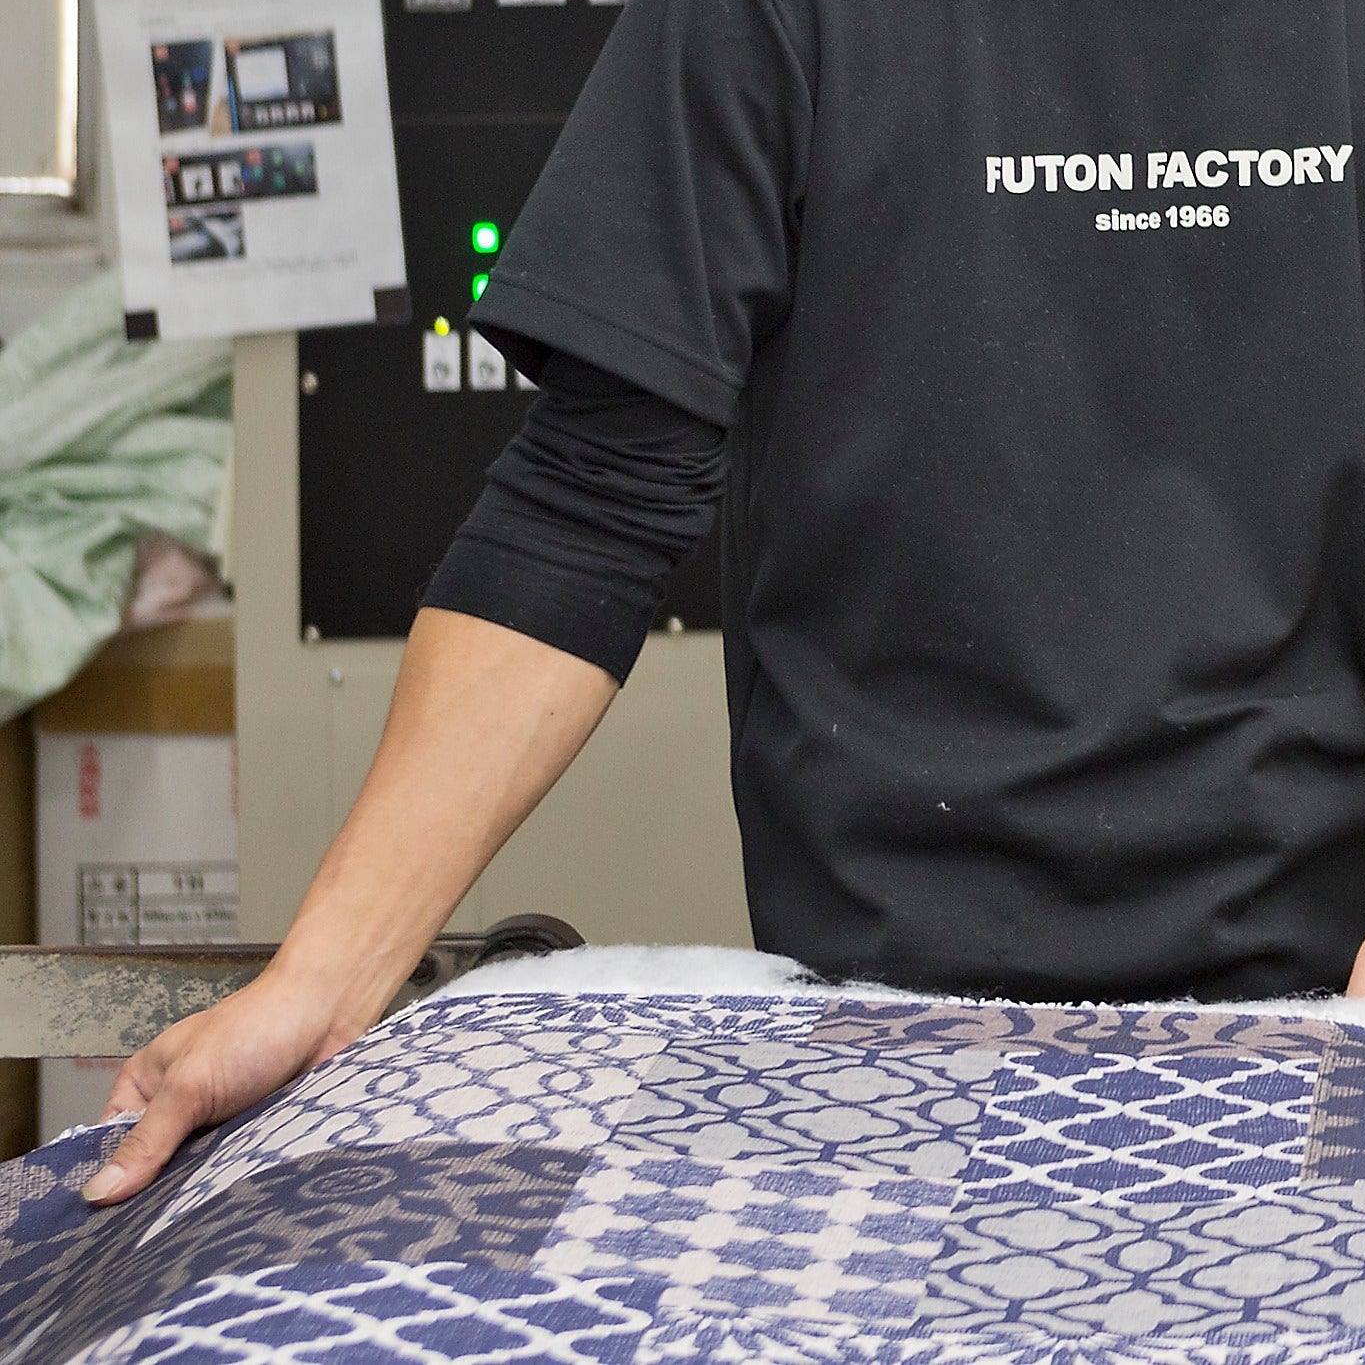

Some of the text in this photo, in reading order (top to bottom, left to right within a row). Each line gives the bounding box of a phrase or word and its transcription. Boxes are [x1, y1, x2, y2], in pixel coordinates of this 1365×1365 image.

[986, 144, 1354, 194] FUTON FACTORY
[1095, 204, 1230, 231] since 1966
